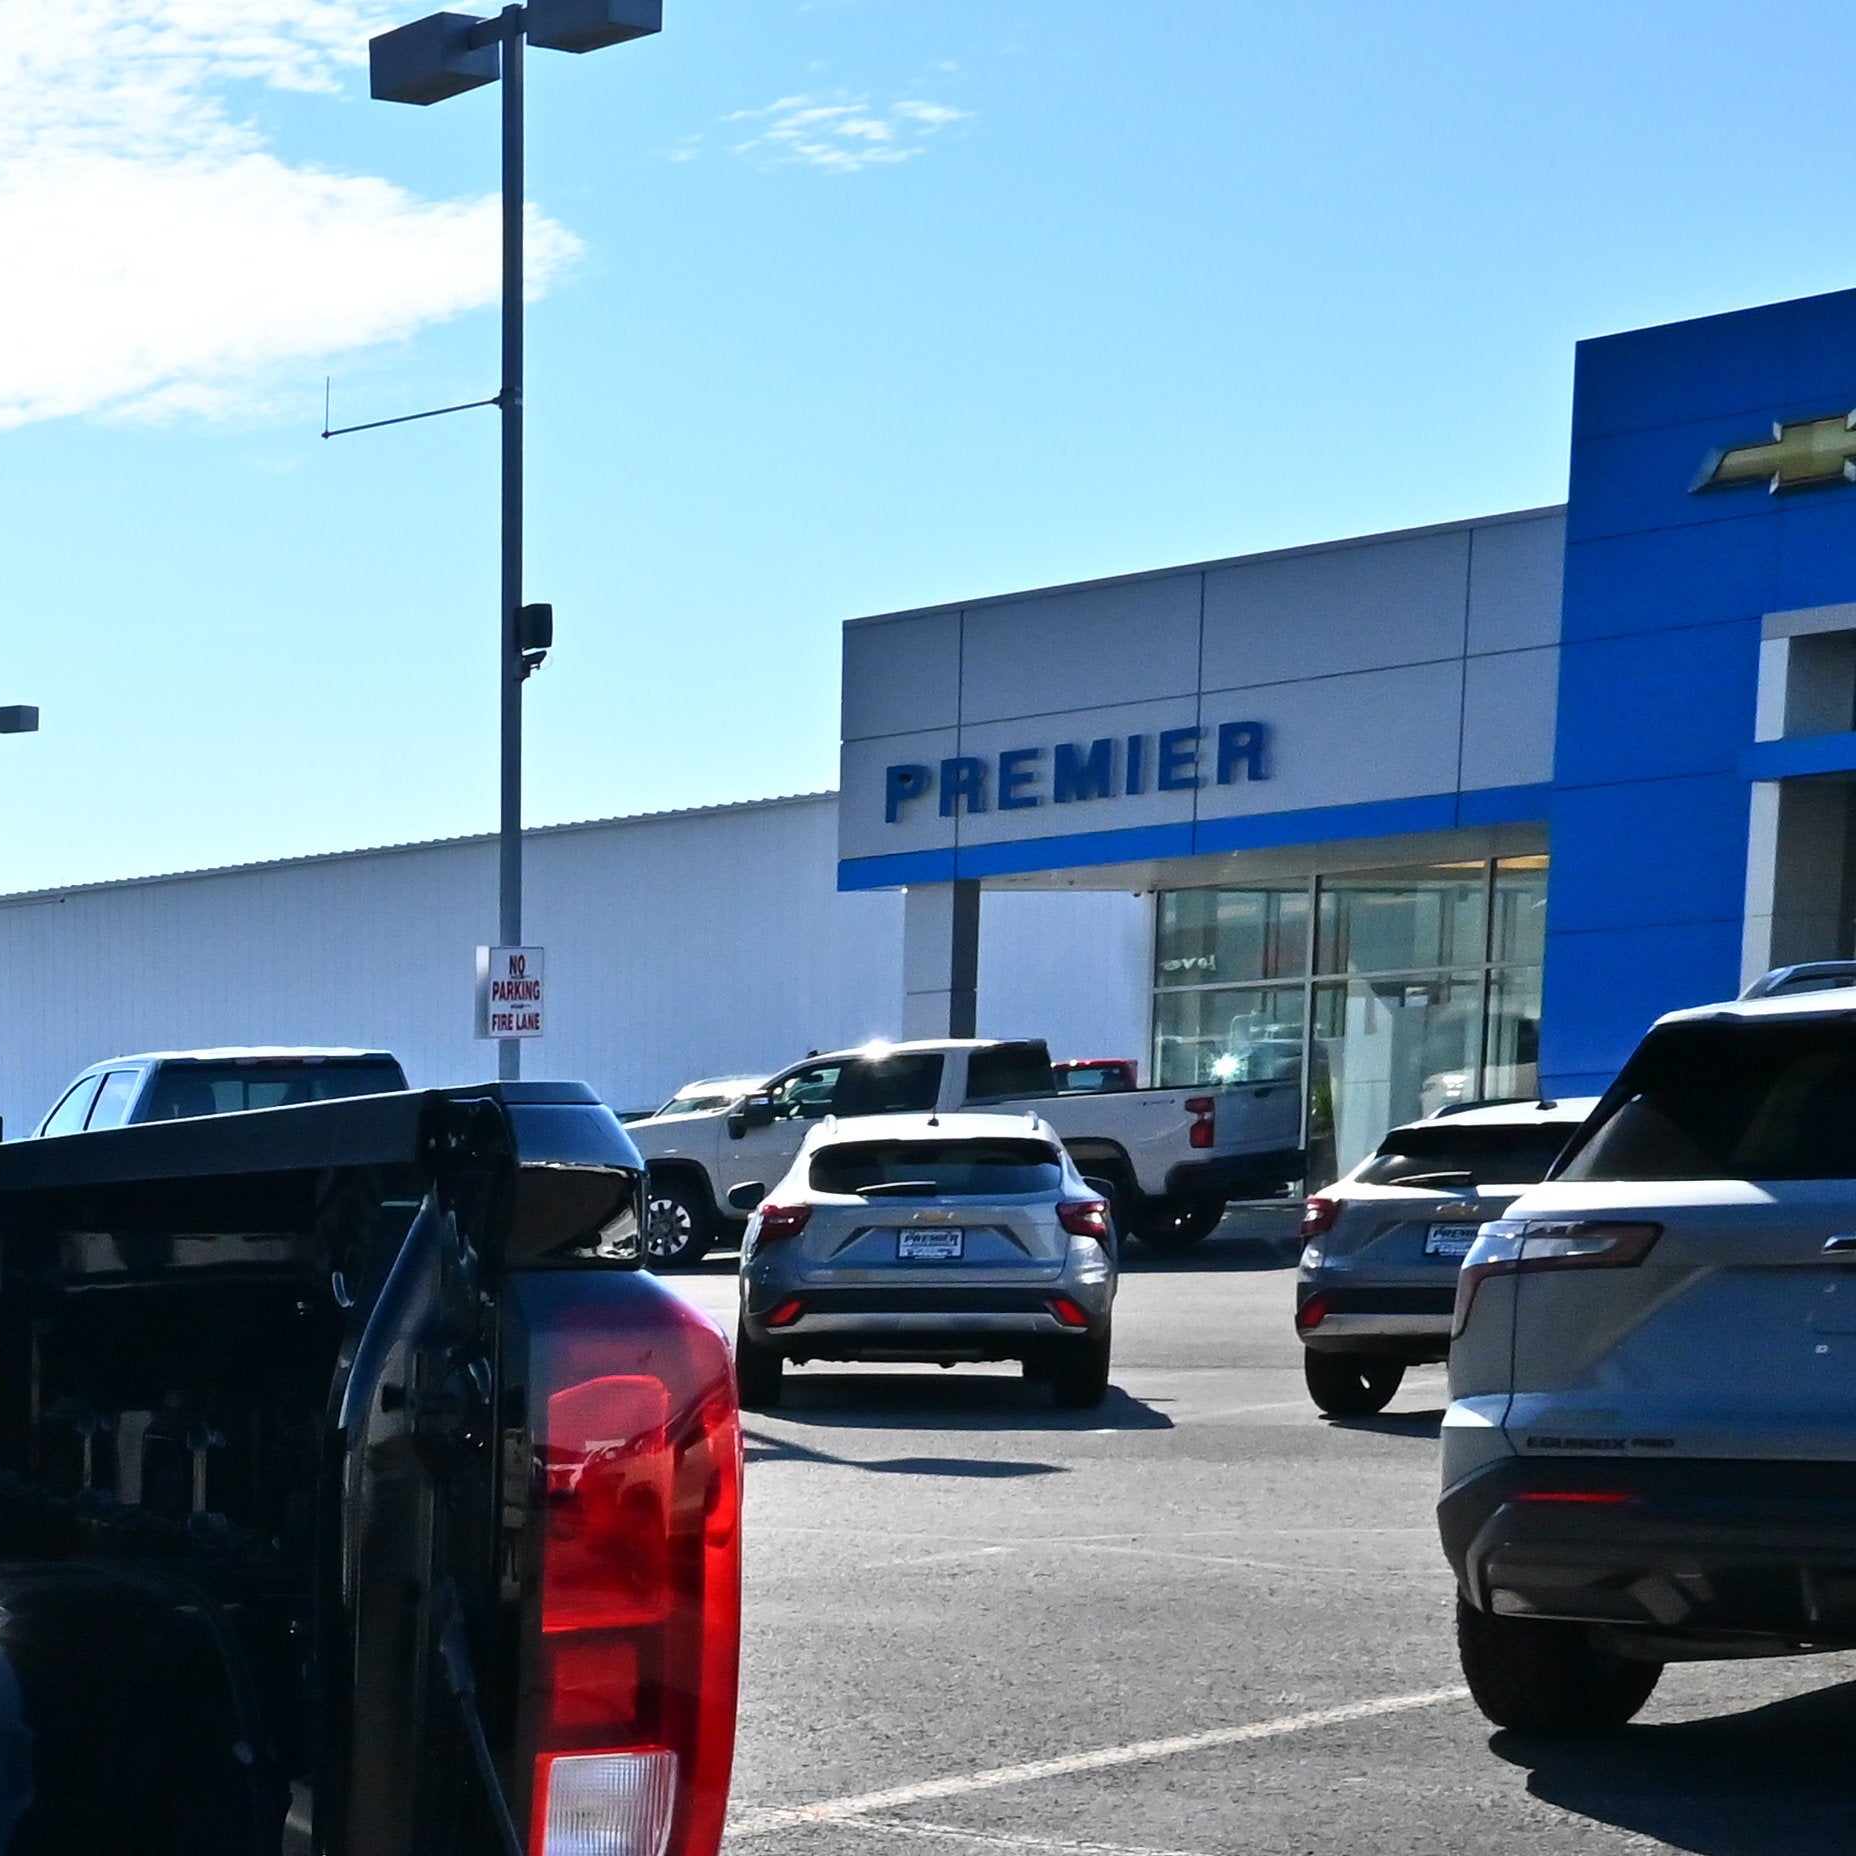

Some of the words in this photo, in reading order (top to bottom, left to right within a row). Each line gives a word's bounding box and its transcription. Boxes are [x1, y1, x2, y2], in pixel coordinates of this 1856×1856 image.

[885, 720, 1271, 824] PREMIER
[509, 954, 526, 978] NO
[492, 980, 540, 1001] PARKING
[491, 1013, 514, 1032] FIRE
[516, 1012, 540, 1031] LANE
